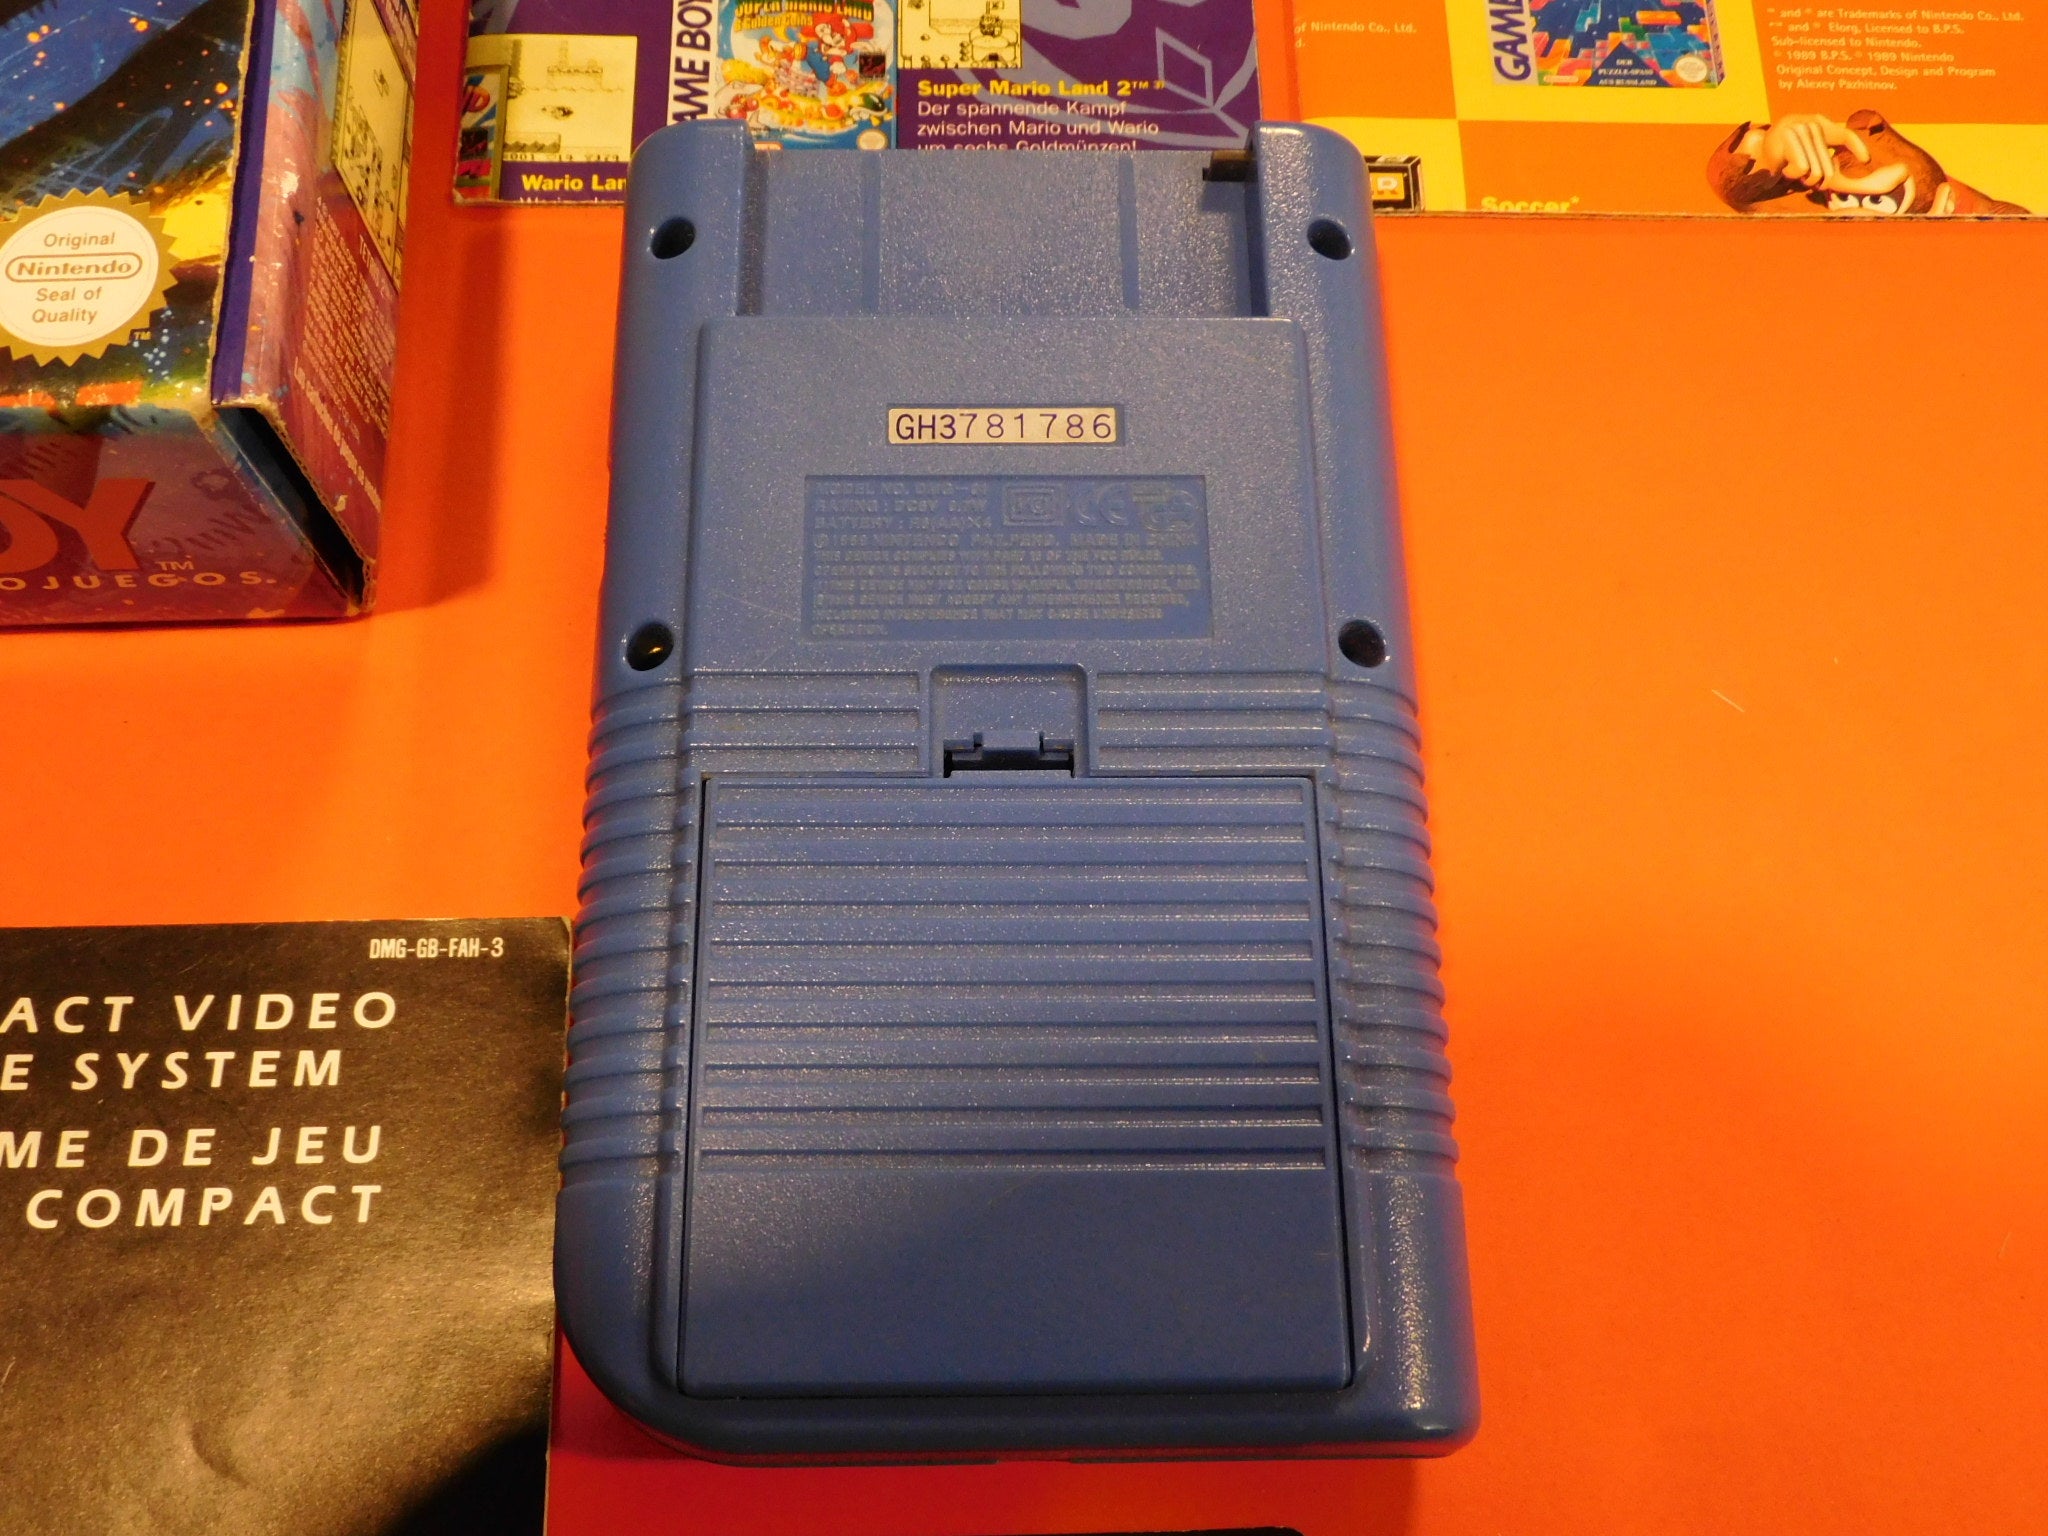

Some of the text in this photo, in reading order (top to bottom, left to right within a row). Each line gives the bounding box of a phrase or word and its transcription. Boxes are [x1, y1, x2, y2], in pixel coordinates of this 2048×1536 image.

[1780, 8, 1802, 17] and
[1838, 8, 1902, 20] Trademarks
[1905, 10, 1918, 19] of
[1921, 11, 1974, 21] Nintendo
[676, 0, 713, 51] BO
[1310, 21, 1365, 32] Nintendo
[1788, 22, 1809, 32] and
[1865, 23, 1912, 34] Licensed
[1917, 24, 1929, 33] to
[1849, 37, 1862, 46] to
[1866, 37, 1921, 48] Nintendo.
[1901, 52, 1954, 63] Nintendo
[1777, 65, 1823, 76] Original
[1881, 66, 1918, 78] Design
[1923, 67, 1943, 77] and
[1947, 67, 1996, 79] Program
[917, 80, 981, 98] Super
[990, 80, 1051, 96] Mario
[1058, 80, 1108, 96] Land
[1778, 78, 1792, 90] by
[1797, 79, 1835, 91] Alexey
[917, 101, 1128, 119] Der spannende Kampf
[917, 120, 1159, 136] zwischen Mario und Wario
[521, 173, 584, 192] Wario
[43, 231, 116, 251] Original
[17, 260, 132, 276] Nintendo
[36, 286, 103, 302] Seal of
[32, 308, 98, 325] Quality
[895, 412, 1112, 441] GH3781786
[369, 937, 505, 960] DMG-GB-FAH-3
[0, 991, 398, 1034] ACT VIDEO
[71, 1049, 342, 1091] SYSTEM
[0, 1125, 382, 1169] ME DE JEU
[26, 1184, 382, 1230] COMPACT
